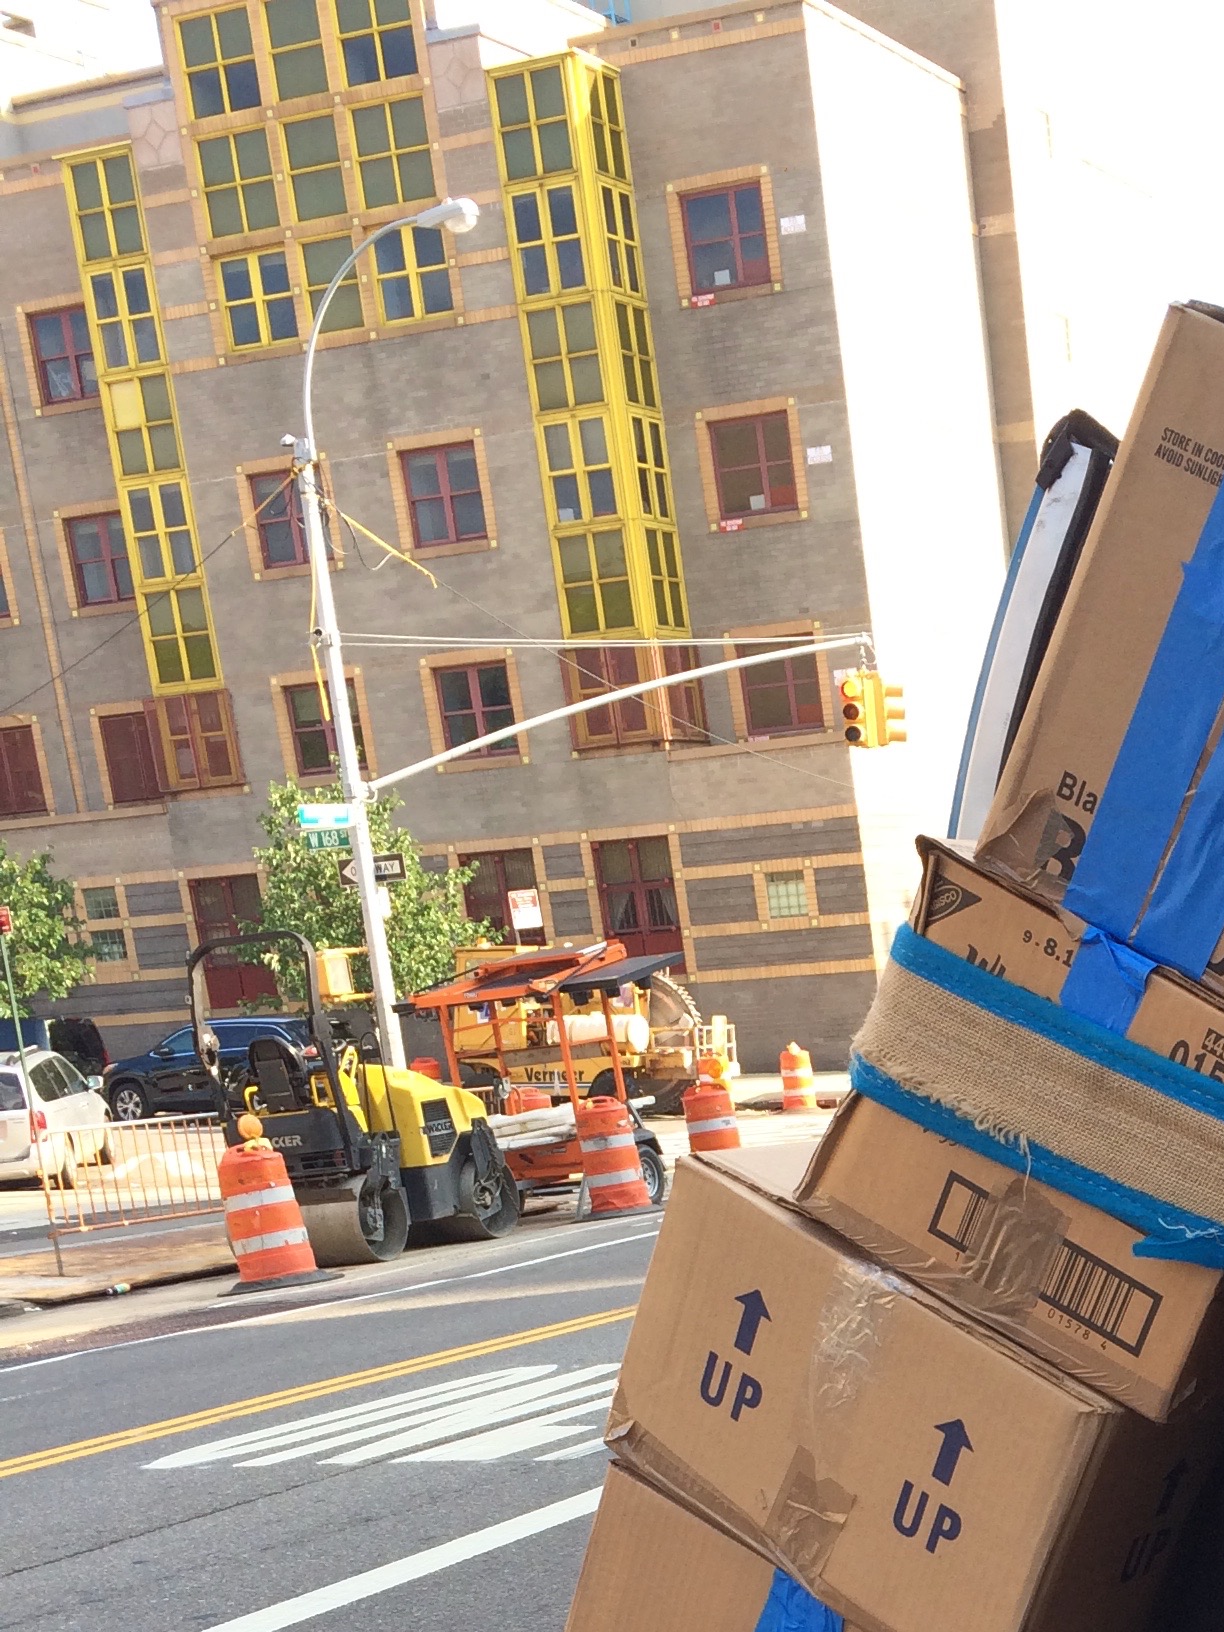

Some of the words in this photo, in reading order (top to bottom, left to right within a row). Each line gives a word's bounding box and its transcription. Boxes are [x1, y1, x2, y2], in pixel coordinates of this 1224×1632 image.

[1154, 443, 1184, 467] AVOID
[1161, 427, 1192, 452] STORE
[1191, 441, 1206, 458] IN
[1056, 770, 1098, 814] Bla
[308, 832, 319, 848] W
[321, 830, 339, 847] 168
[375, 862, 395, 874] WAY
[699, 1351, 763, 1421] UP
[892, 1480, 963, 1553] UP
